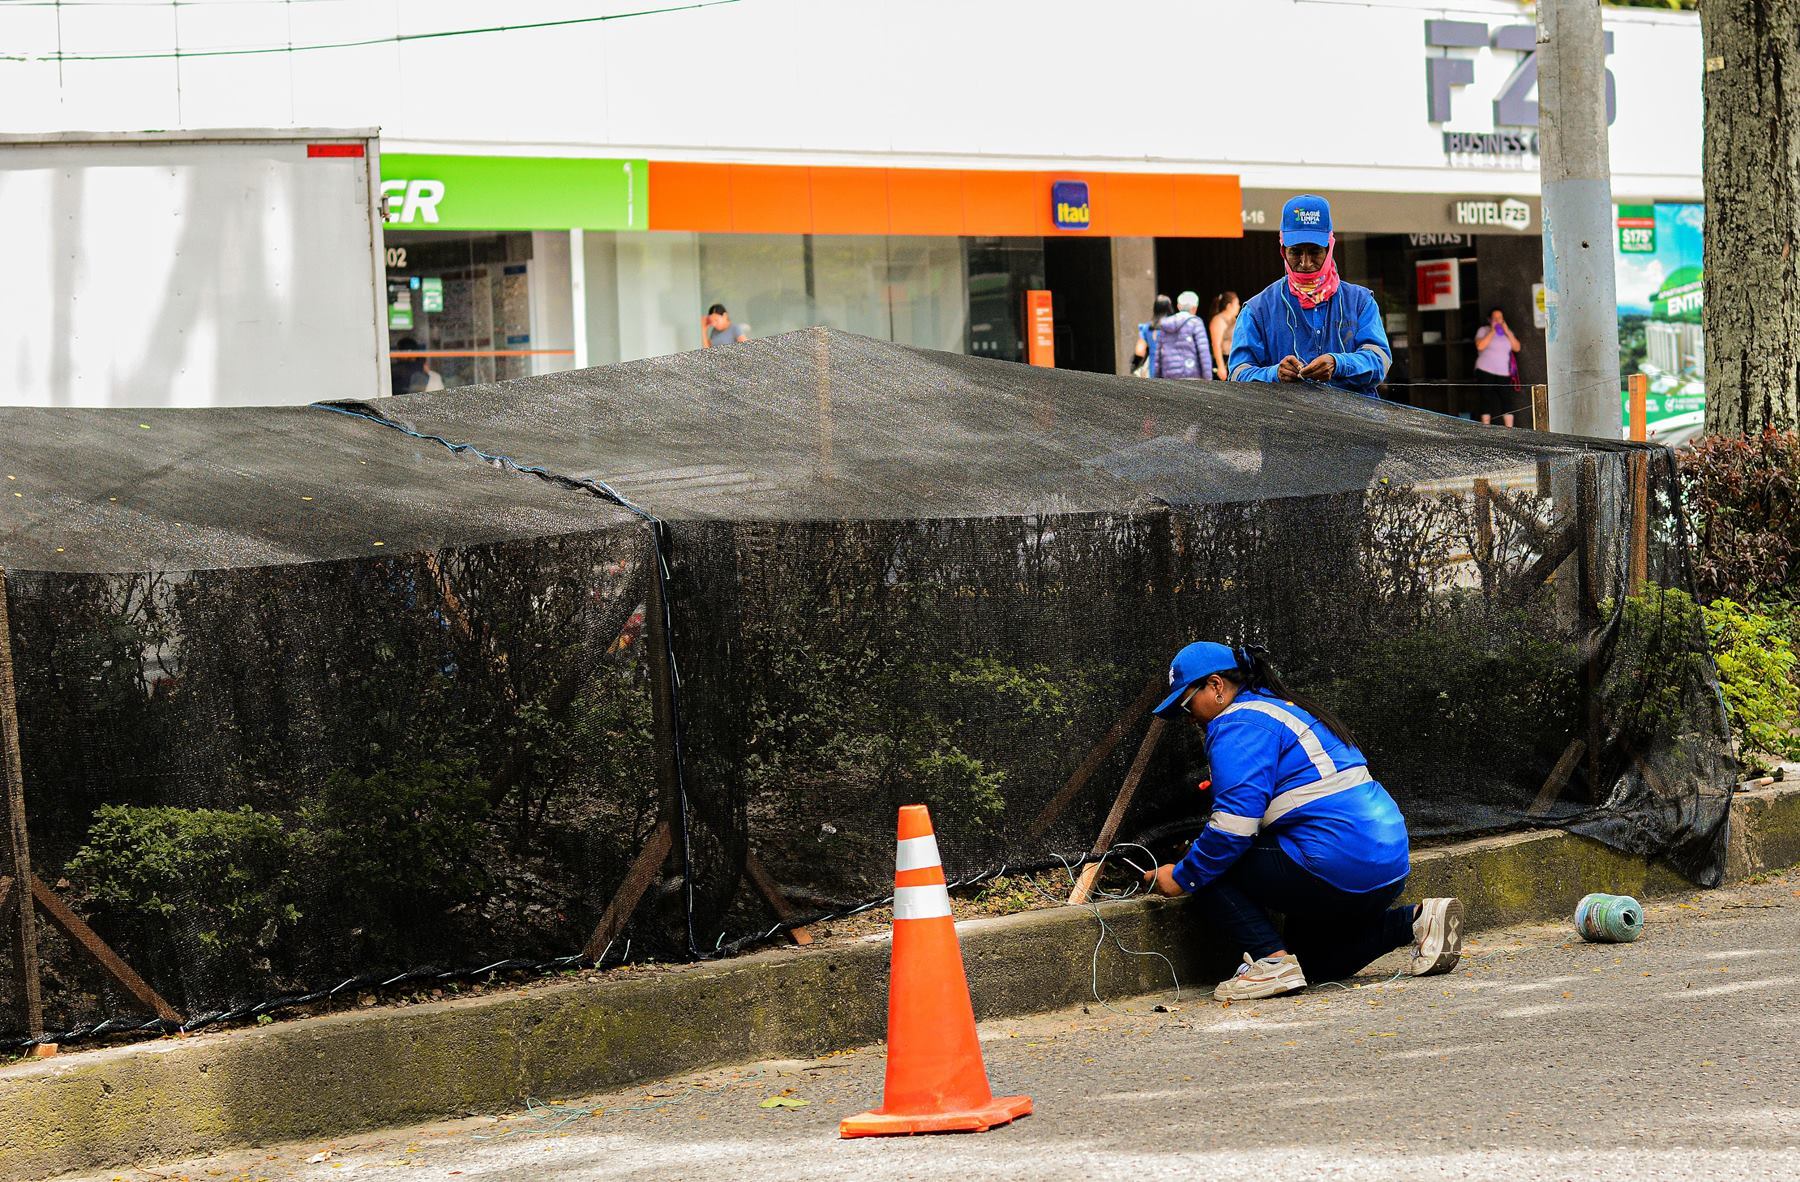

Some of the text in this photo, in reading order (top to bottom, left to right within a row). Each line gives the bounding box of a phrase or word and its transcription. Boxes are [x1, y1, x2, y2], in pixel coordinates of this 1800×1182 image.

[1443, 131, 1527, 155] BUSINESS
[1057, 203, 1089, 223] Itaú
[1456, 201, 1501, 225] HOTEL
[1408, 233, 1462, 247] VENTAS
